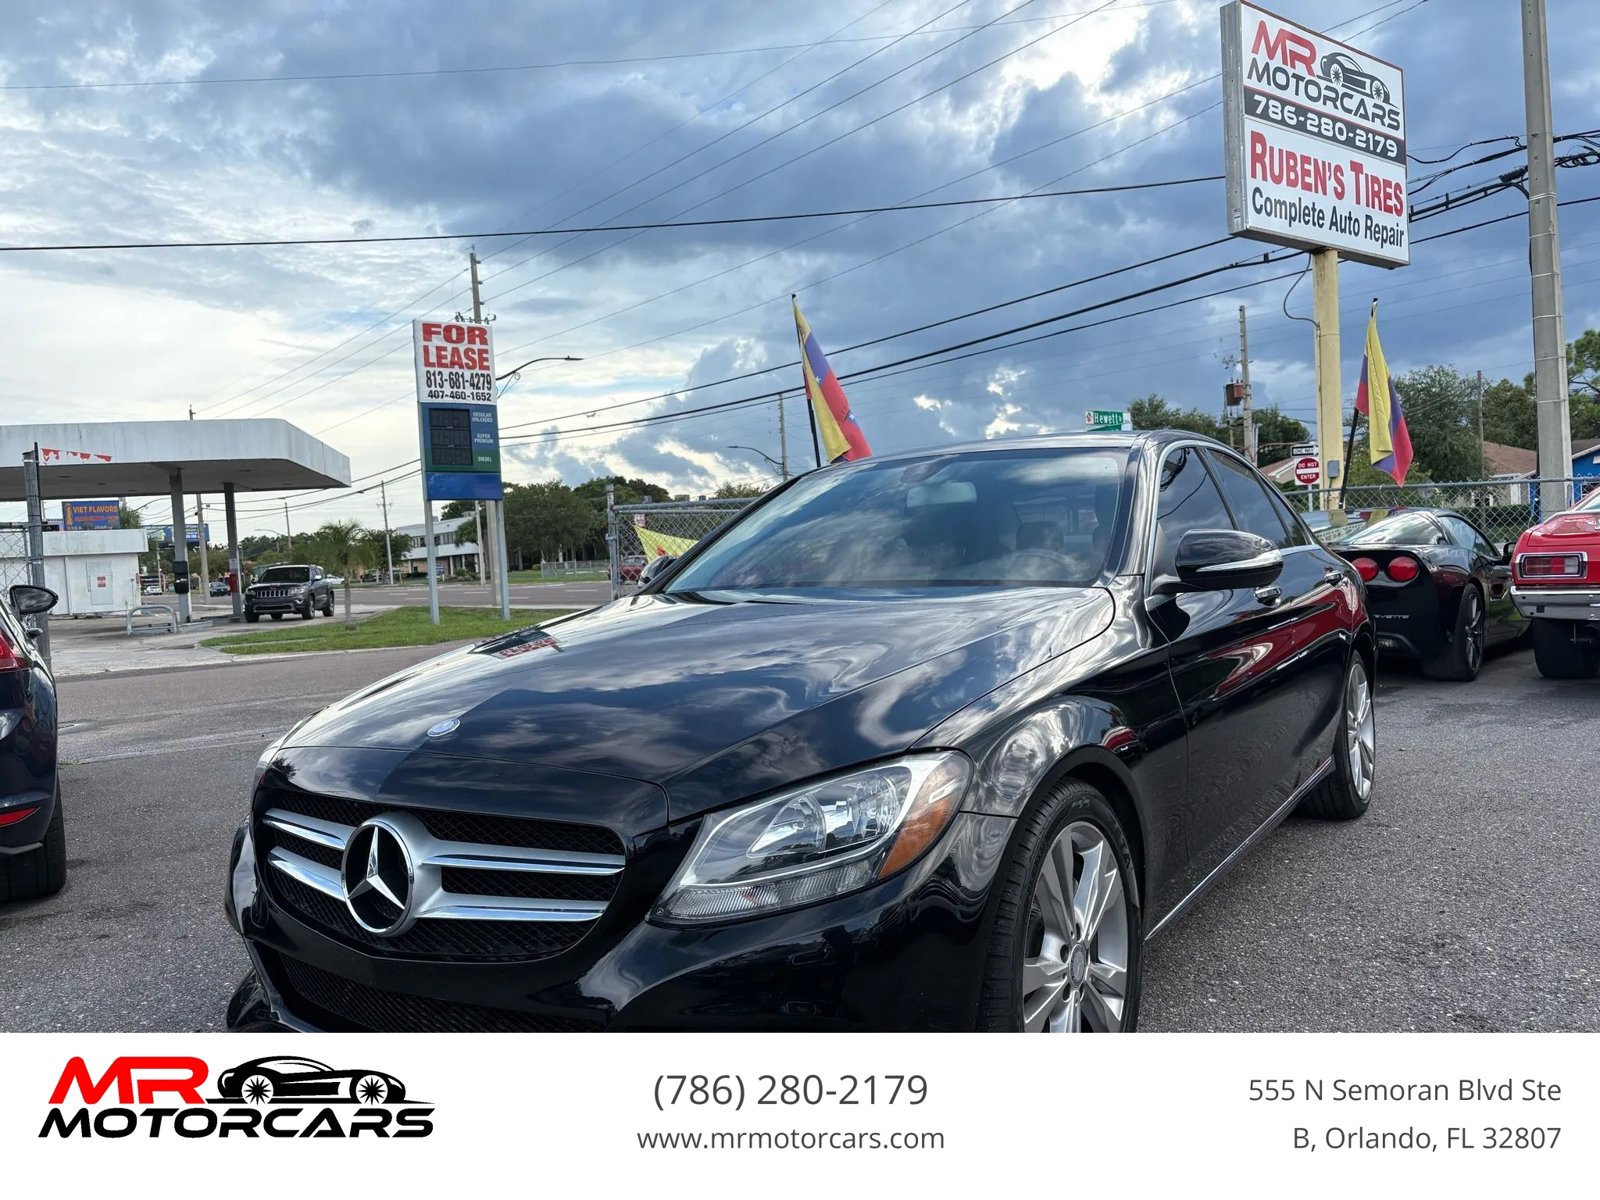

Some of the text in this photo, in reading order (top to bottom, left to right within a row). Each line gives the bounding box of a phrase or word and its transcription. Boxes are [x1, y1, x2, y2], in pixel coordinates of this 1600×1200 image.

[1251, 20, 1317, 77] MR
[1247, 57, 1400, 131] MOTORCARS
[1253, 95, 1398, 158] 786-280-2179
[1250, 130, 1404, 217] RUBEN'S TIRES
[1252, 186, 1404, 249] Complete Auto Repair
[422, 323, 489, 346] FOR
[422, 345, 490, 371] LEASE
[425, 370, 492, 391] 813-681-4279
[427, 390, 492, 401] 407-460-1652
[88, 505, 118, 513] FLAVORS
